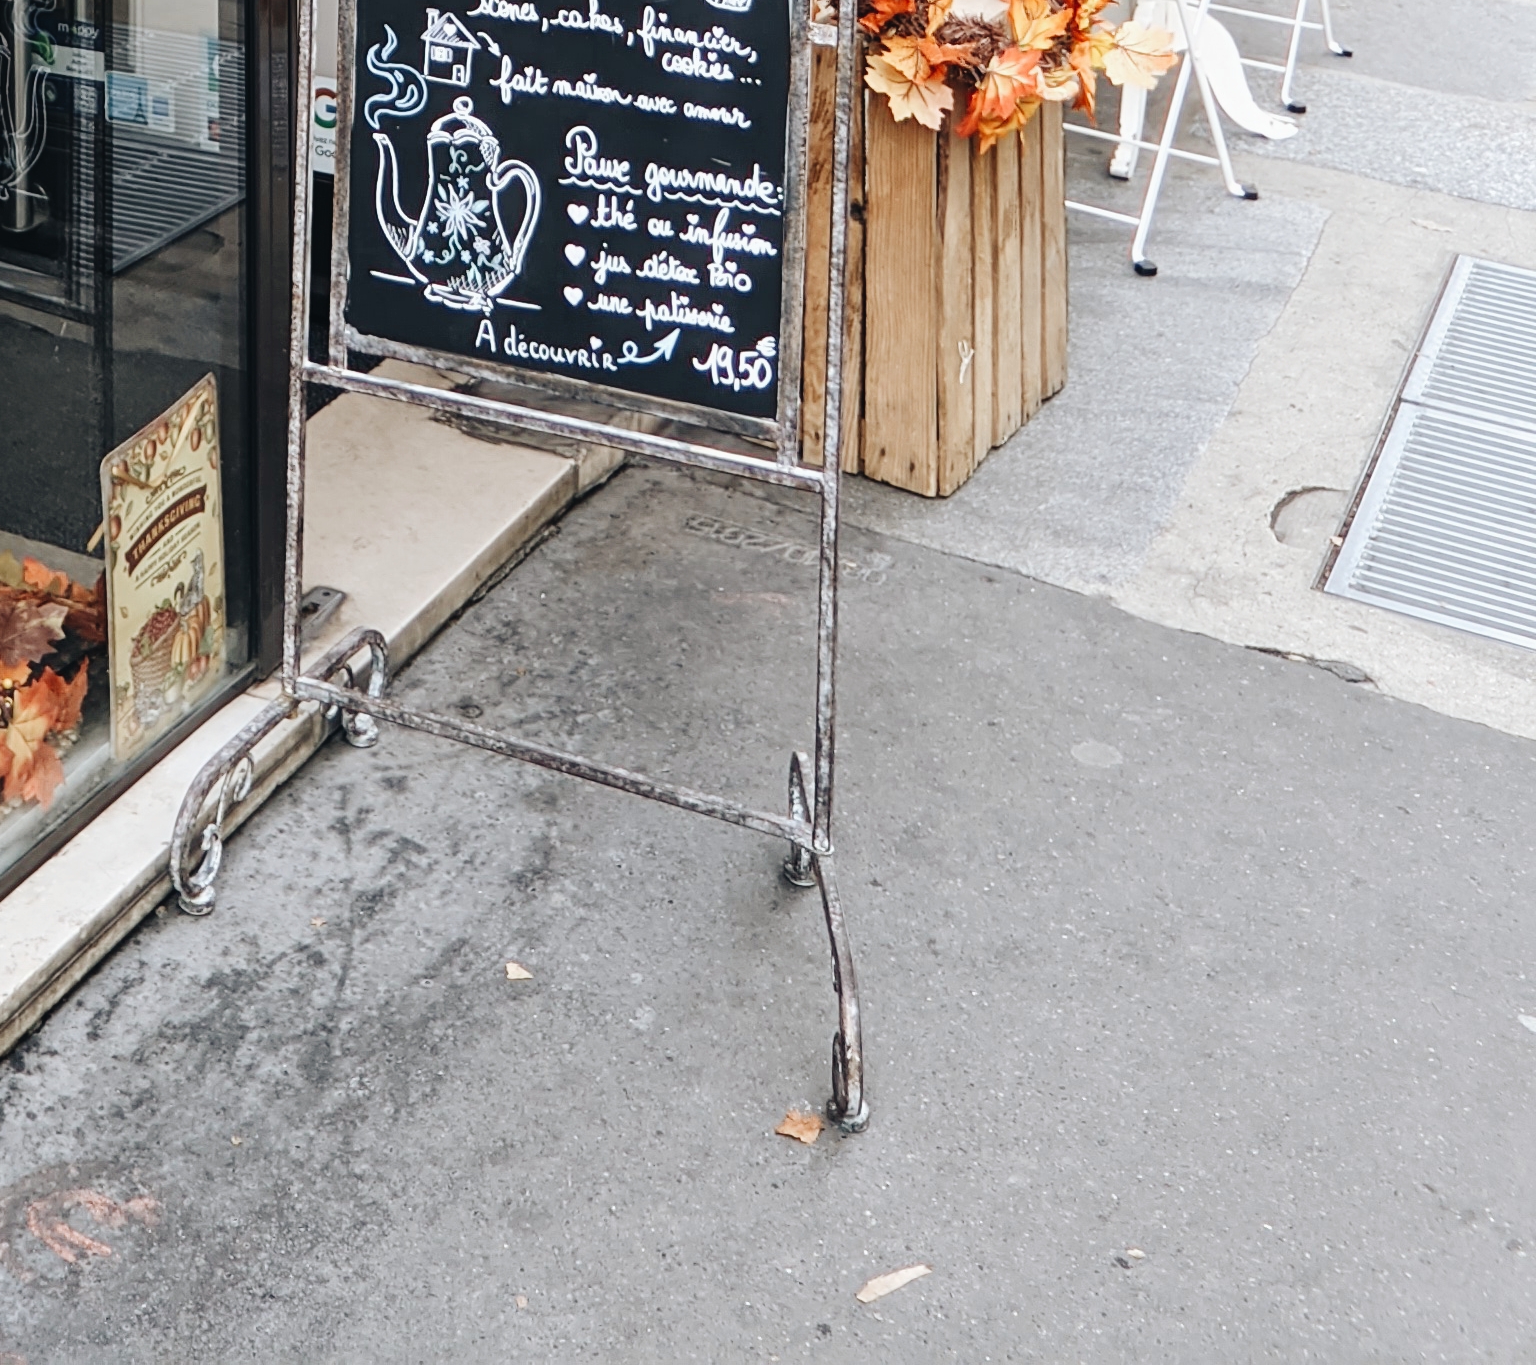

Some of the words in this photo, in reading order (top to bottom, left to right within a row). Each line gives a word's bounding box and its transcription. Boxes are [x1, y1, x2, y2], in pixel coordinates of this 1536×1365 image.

[489, 54, 549, 104] fait
[552, 72, 633, 105] maison
[633, 93, 678, 114] avec
[683, 101, 752, 129] amour
[564, 125, 631, 184] Pause
[590, 197, 637, 231] thé
[647, 219, 675, 238] ou
[681, 207, 778, 259] infusion
[591, 242, 632, 285] jus
[636, 250, 701, 285] détox
[587, 292, 634, 315] une
[131, 493, 202, 560] THANKSGIVING
